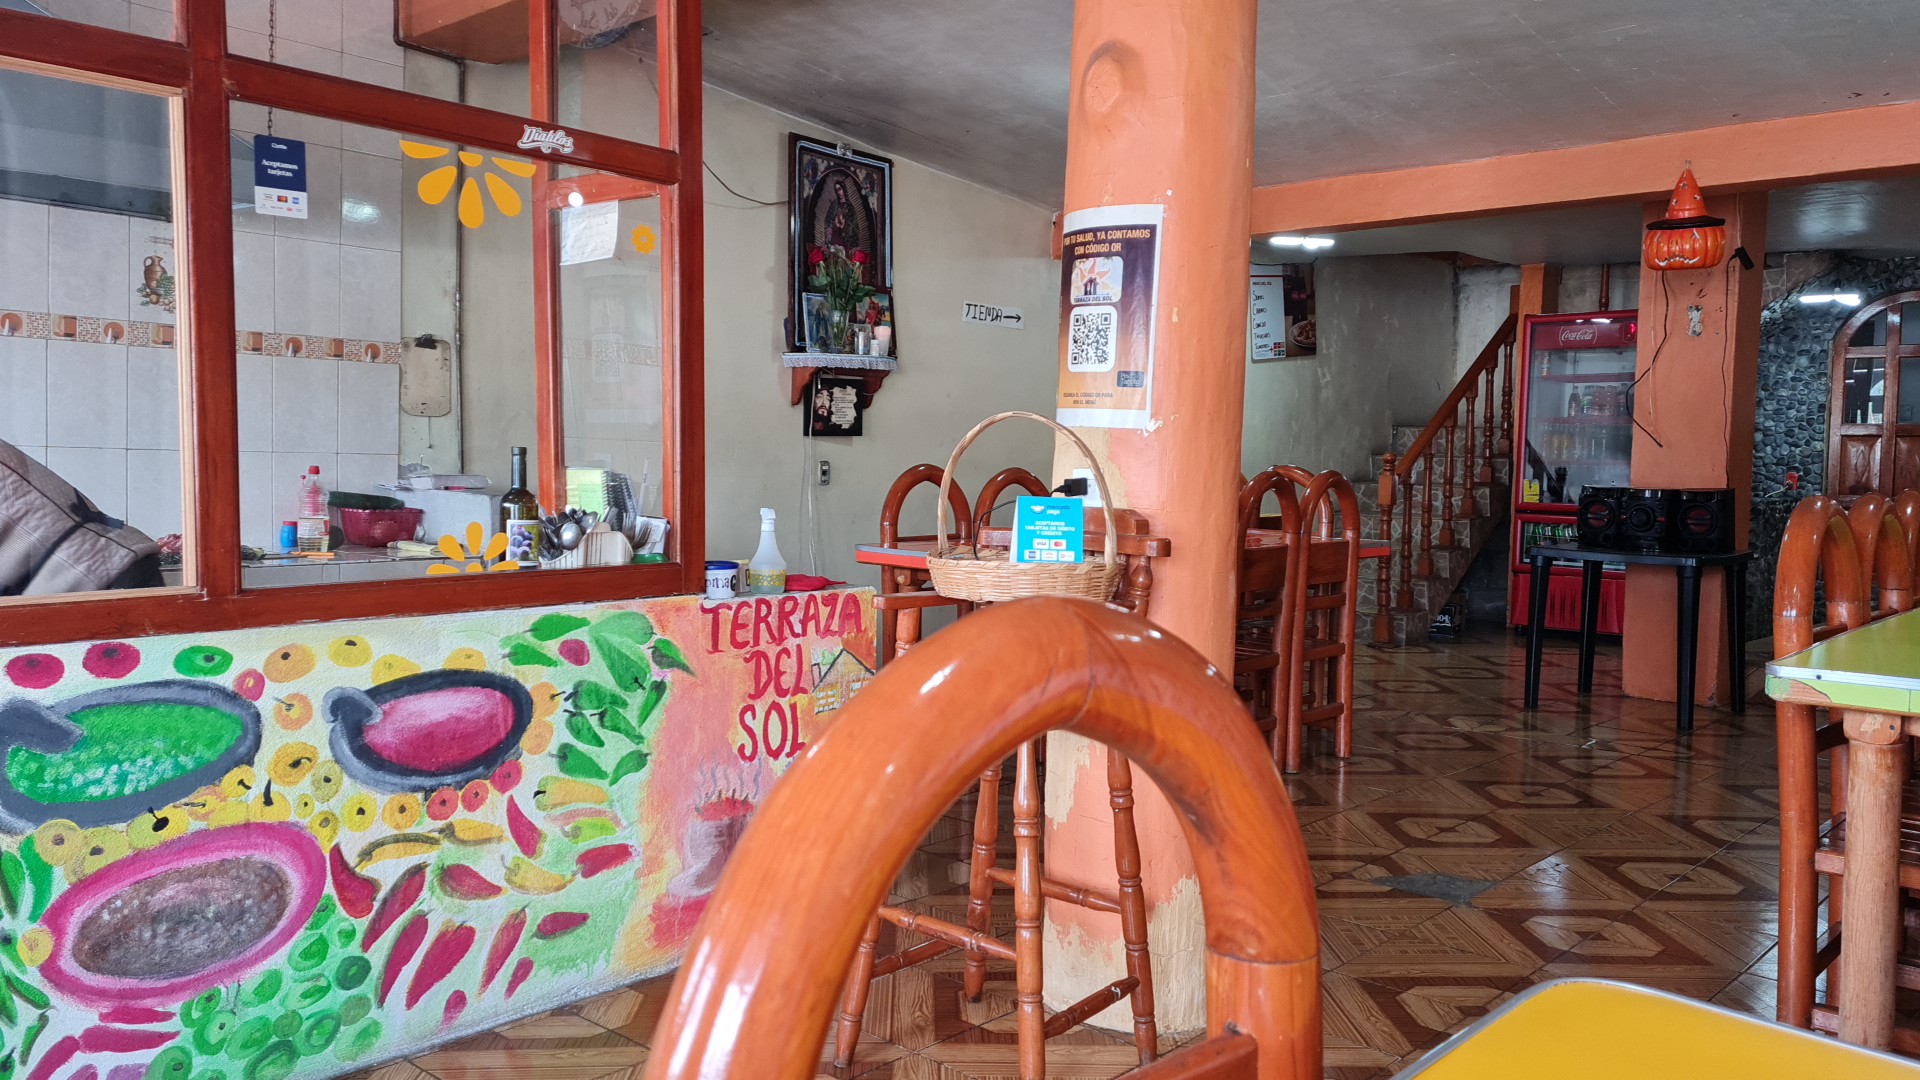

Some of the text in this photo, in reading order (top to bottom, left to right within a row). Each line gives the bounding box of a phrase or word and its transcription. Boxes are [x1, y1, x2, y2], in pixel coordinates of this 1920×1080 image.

[520, 125, 573, 149] Diablos
[262, 159, 299, 170] Aceptamos
[267, 168, 293, 177] tarjetas
[1077, 233, 1095, 242] SALUD,
[1097, 231, 1106, 240] YA
[1108, 229, 1150, 239] CONTAMOS
[1075, 242, 1121, 255] CON CÓDIGO QR
[965, 303, 1003, 322] TIENDA
[701, 593, 863, 655] TERRAZA
[743, 644, 809, 700] DEL
[737, 699, 807, 763] SOL
